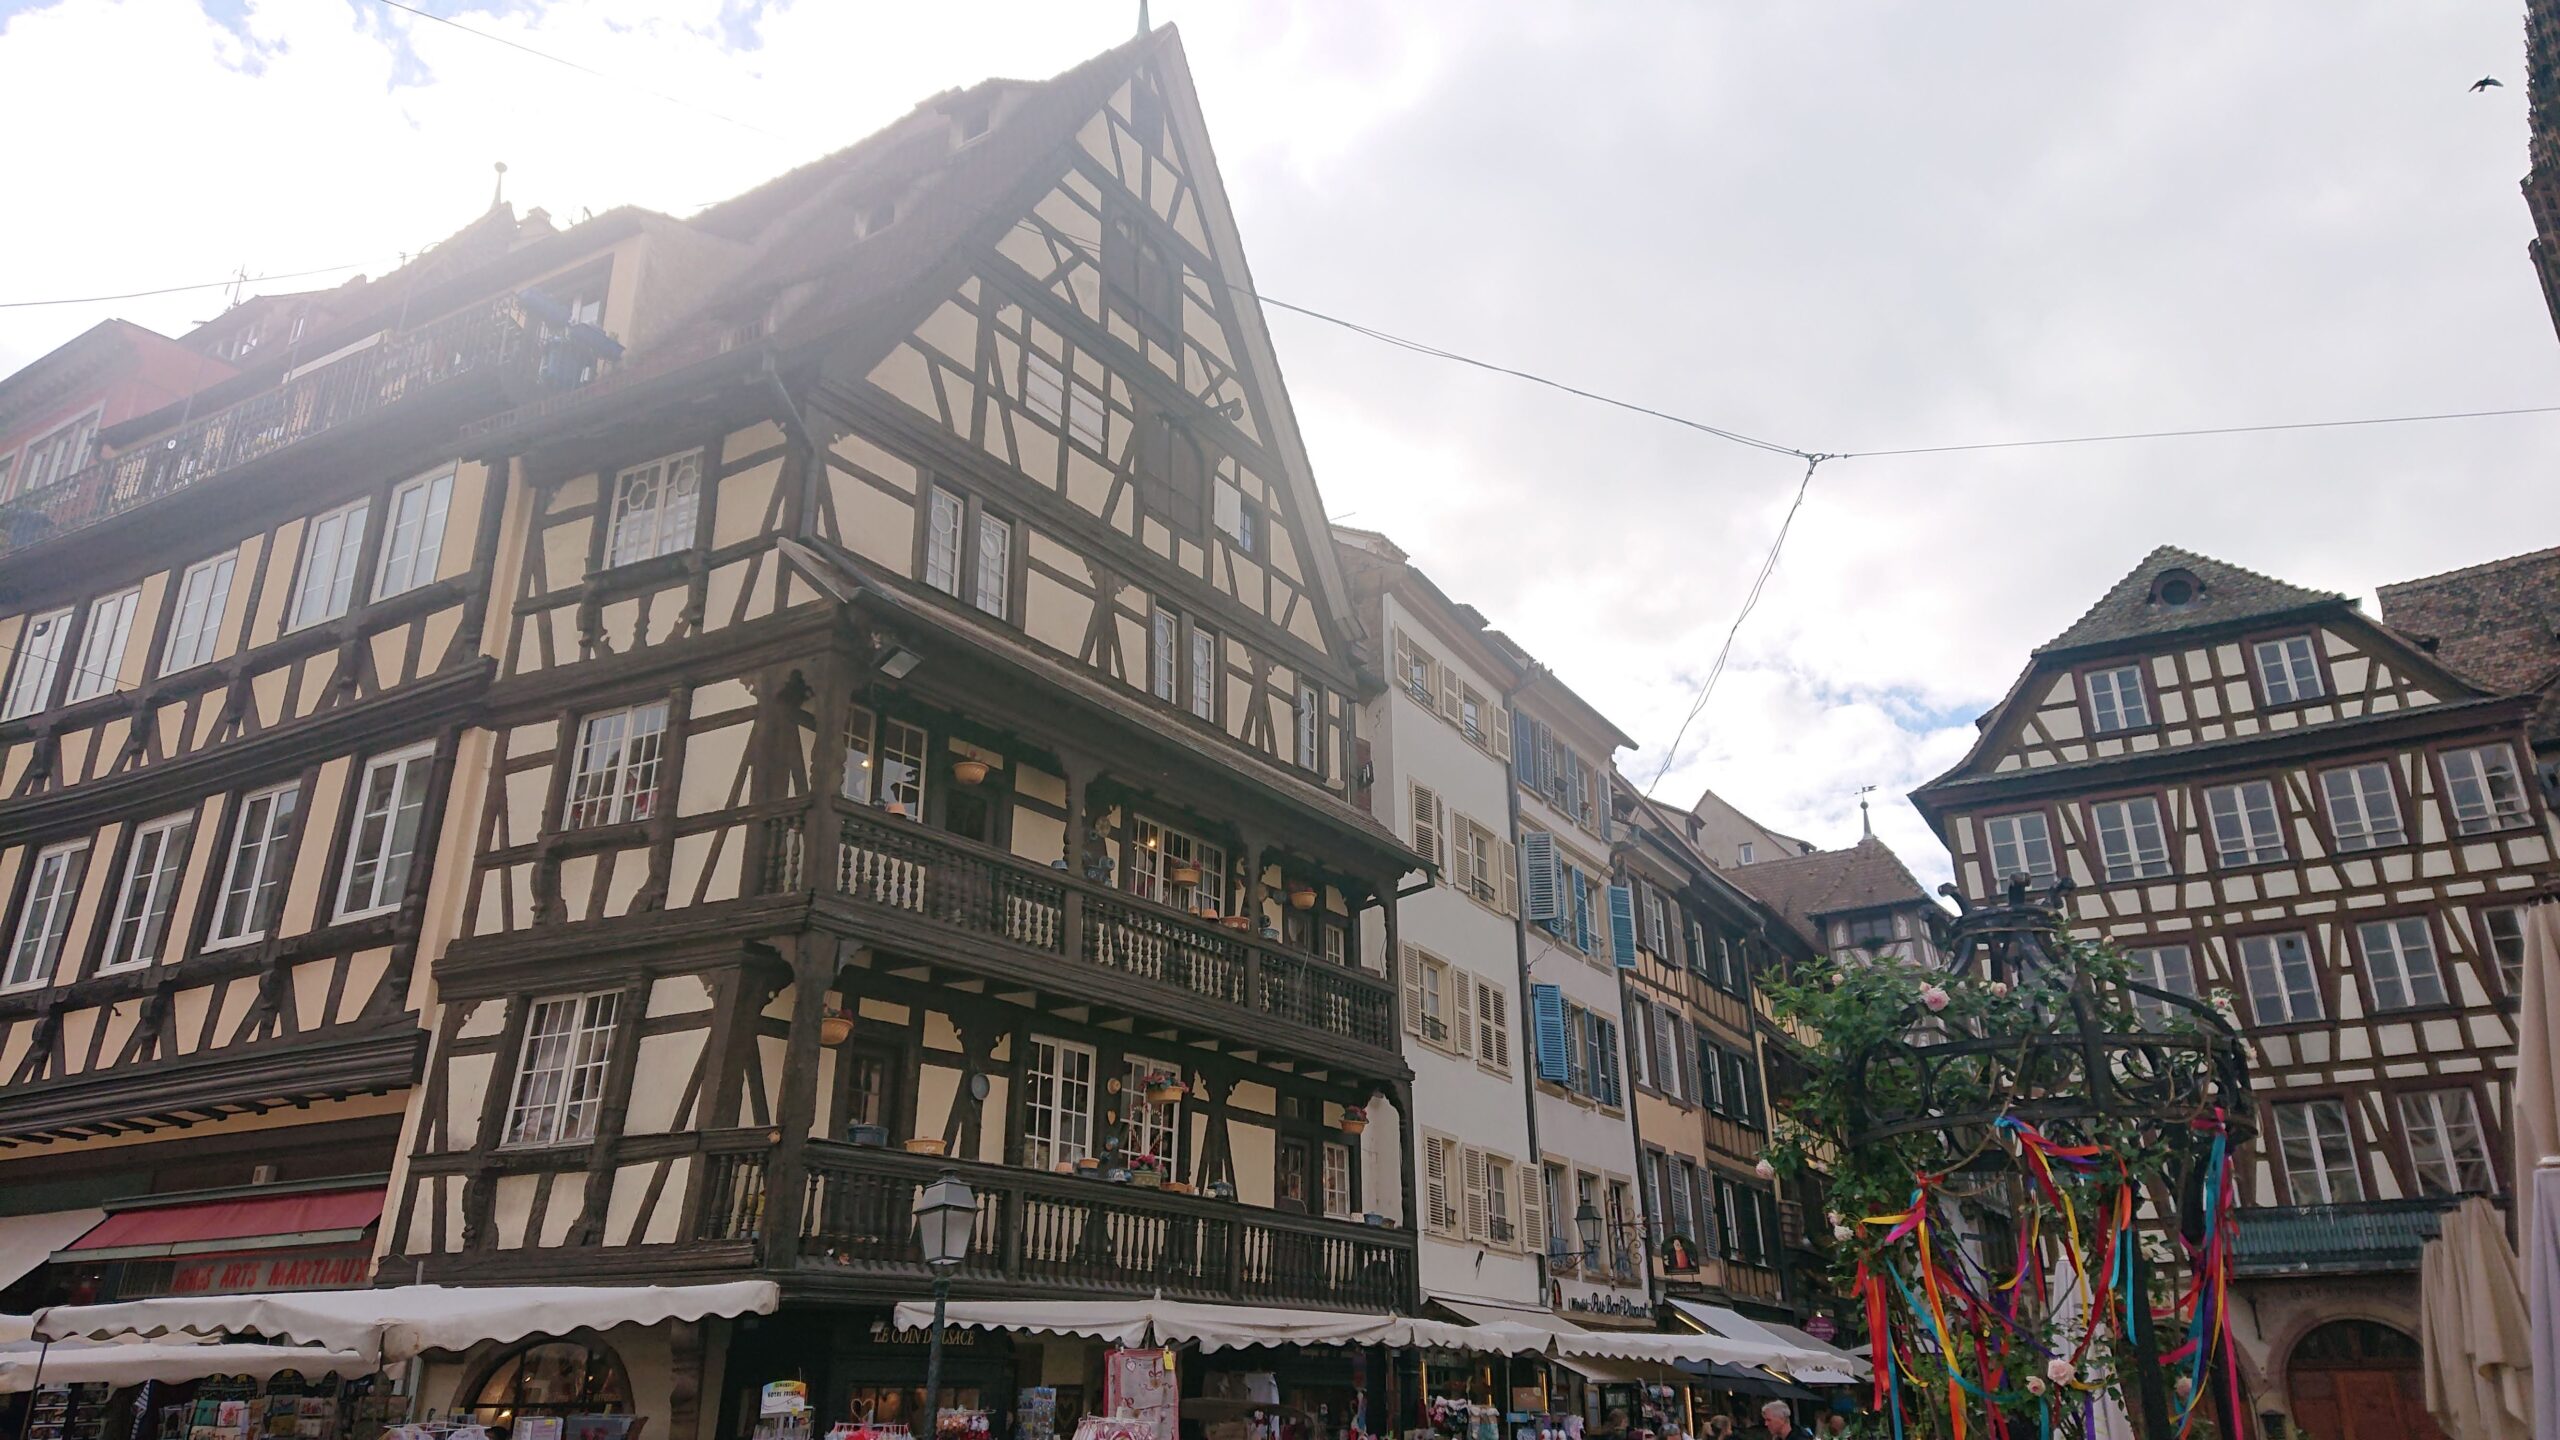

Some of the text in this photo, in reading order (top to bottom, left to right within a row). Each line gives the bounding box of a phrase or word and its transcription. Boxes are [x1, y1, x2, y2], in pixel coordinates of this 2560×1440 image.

[219, 1261, 262, 1288] ARTS
[268, 1258, 369, 1286] MARTIAUX
[892, 1328, 920, 1344] COIN
